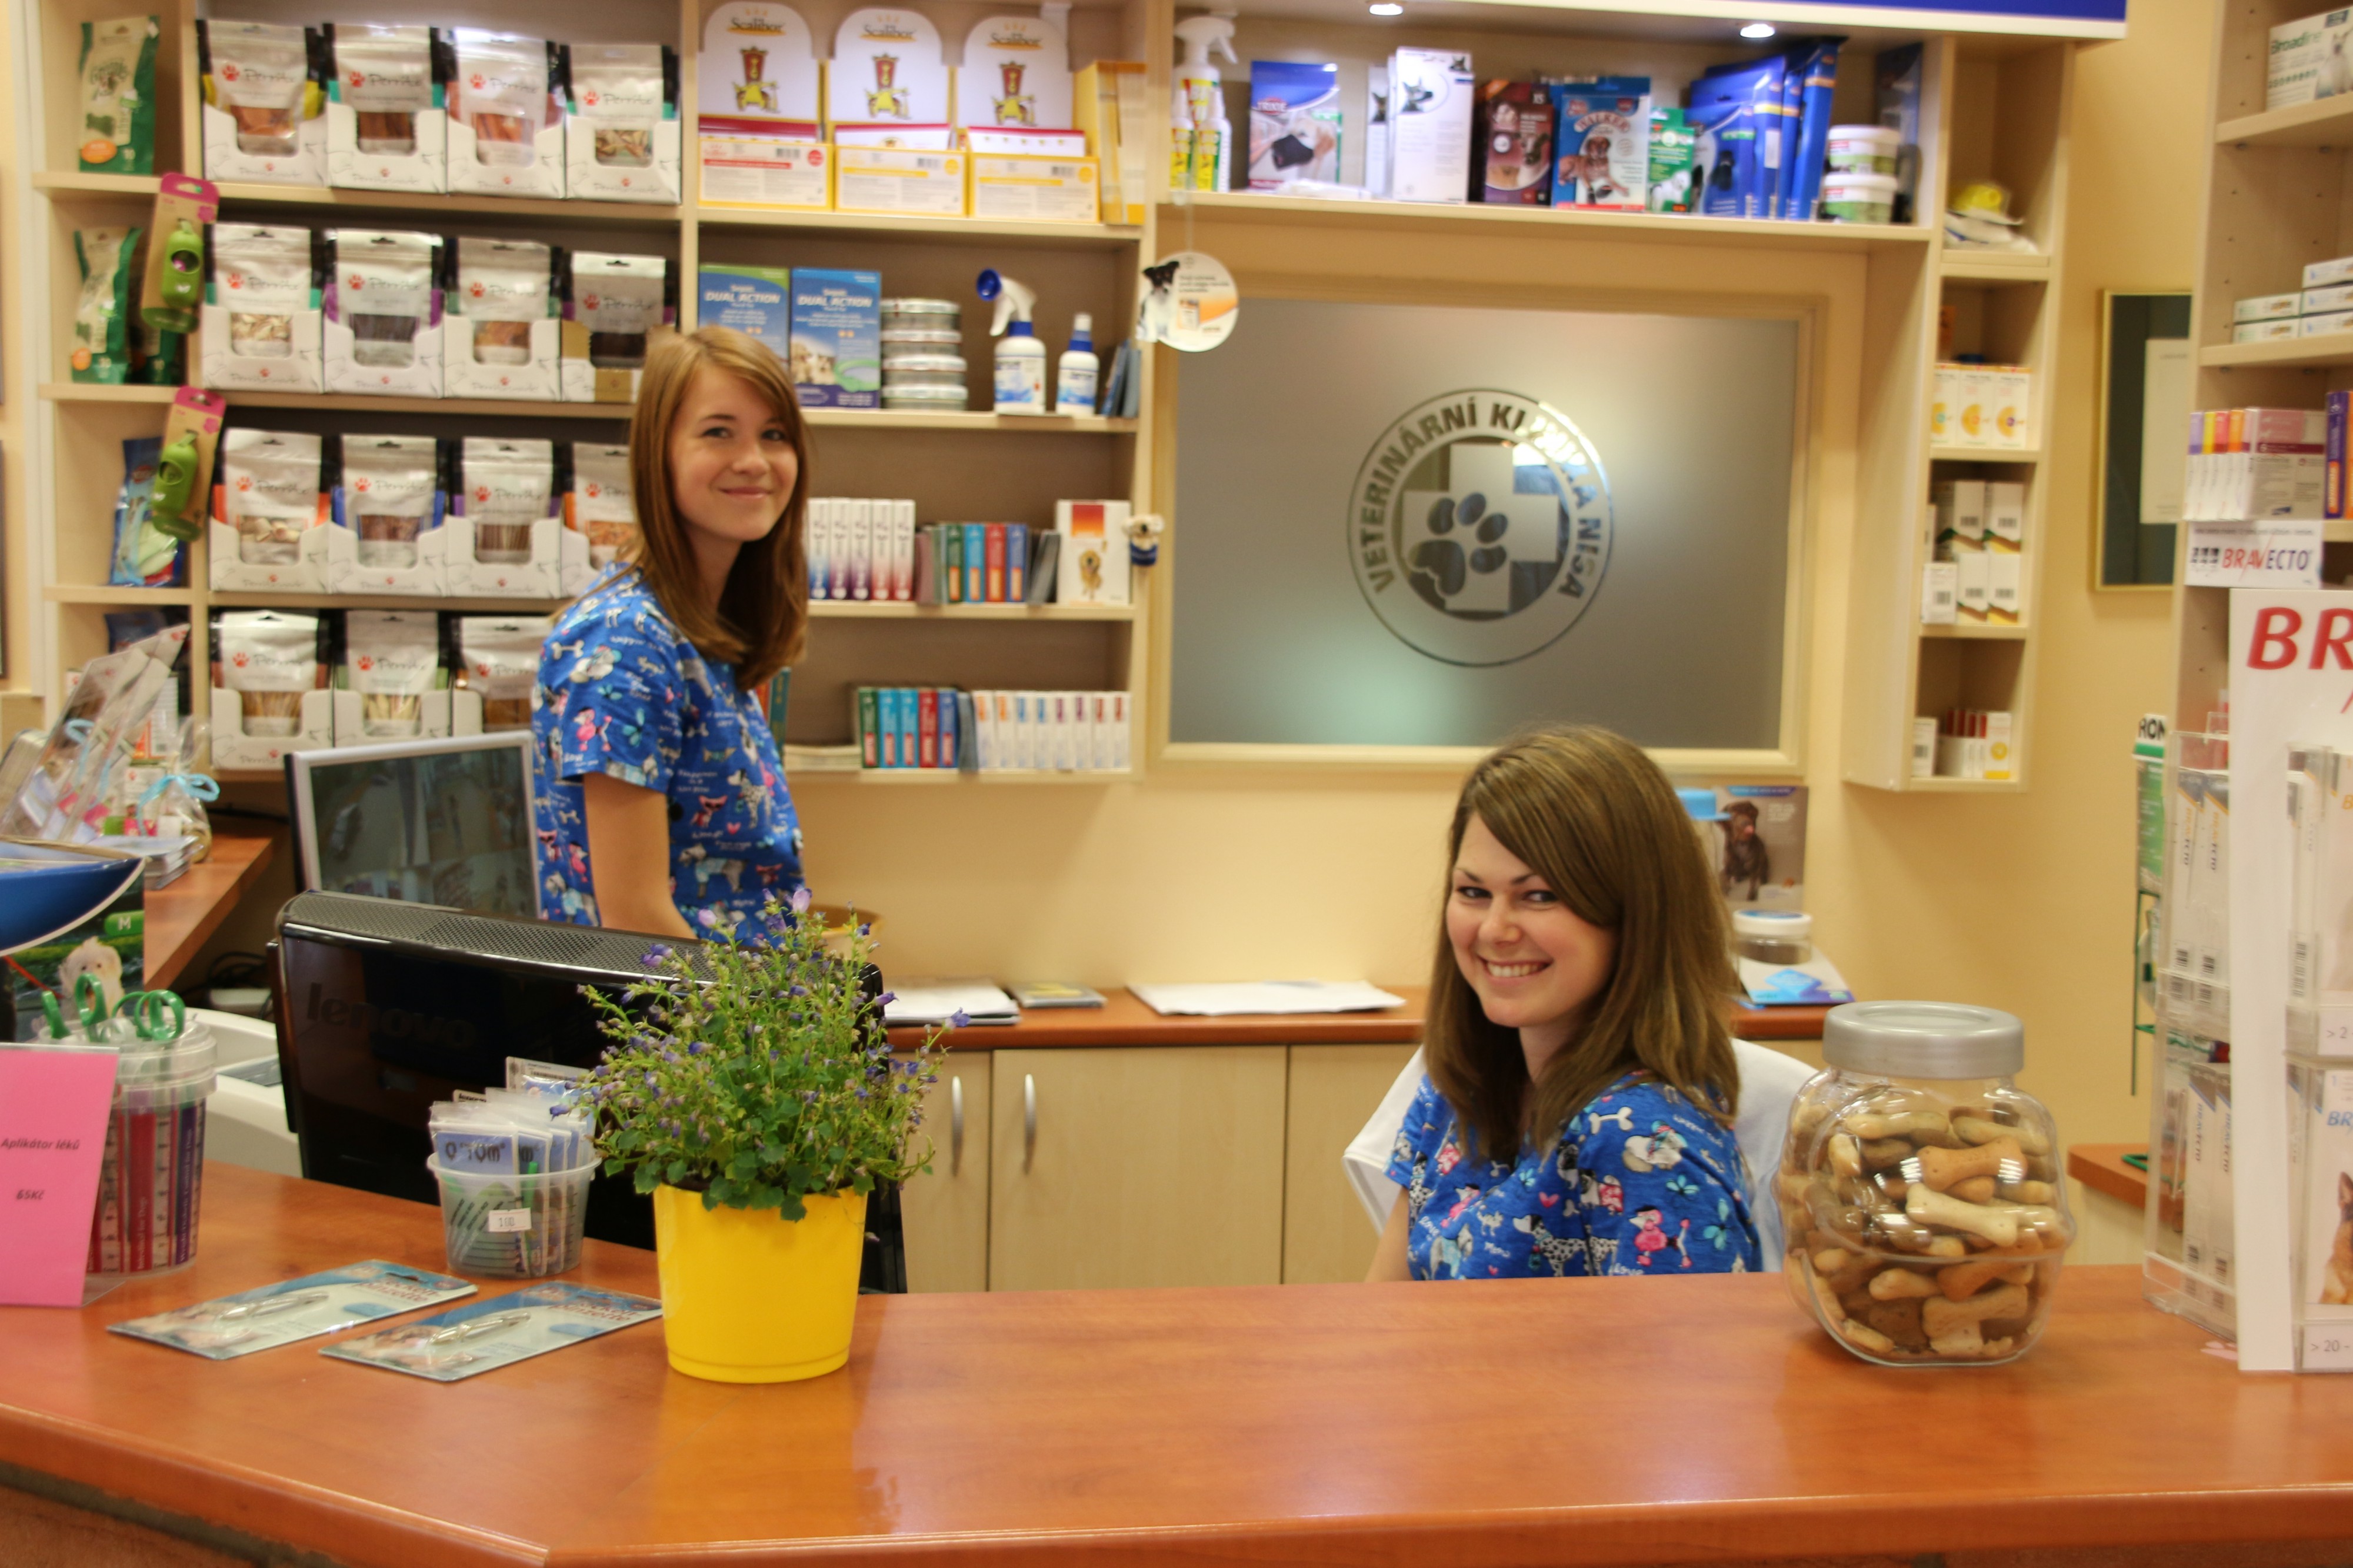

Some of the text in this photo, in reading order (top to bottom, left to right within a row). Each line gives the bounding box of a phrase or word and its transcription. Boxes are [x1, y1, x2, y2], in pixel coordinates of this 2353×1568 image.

[731, 17, 784, 32] Scalibor
[863, 24, 915, 39] Scalibor
[991, 32, 1042, 48] Scalibor
[1257, 101, 1288, 112] TRIXIE
[704, 292, 781, 305] DUAL ACTION
[797, 295, 873, 308] DUAL ACTION
[1360, 396, 1477, 593] VETERINÁRNÍ
[2221, 542, 2312, 574] BRAVECTO
[119, 916, 131, 930] M
[306, 982, 478, 1050] lenovo
[2339, 1027, 2348, 1039] 2
[1, 1138, 80, 1150] Aplikátor léků
[16, 1189, 45, 1200] 65Kč
[138, 1196, 148, 1217] Dogs
[2324, 1339, 2340, 1352] 20
